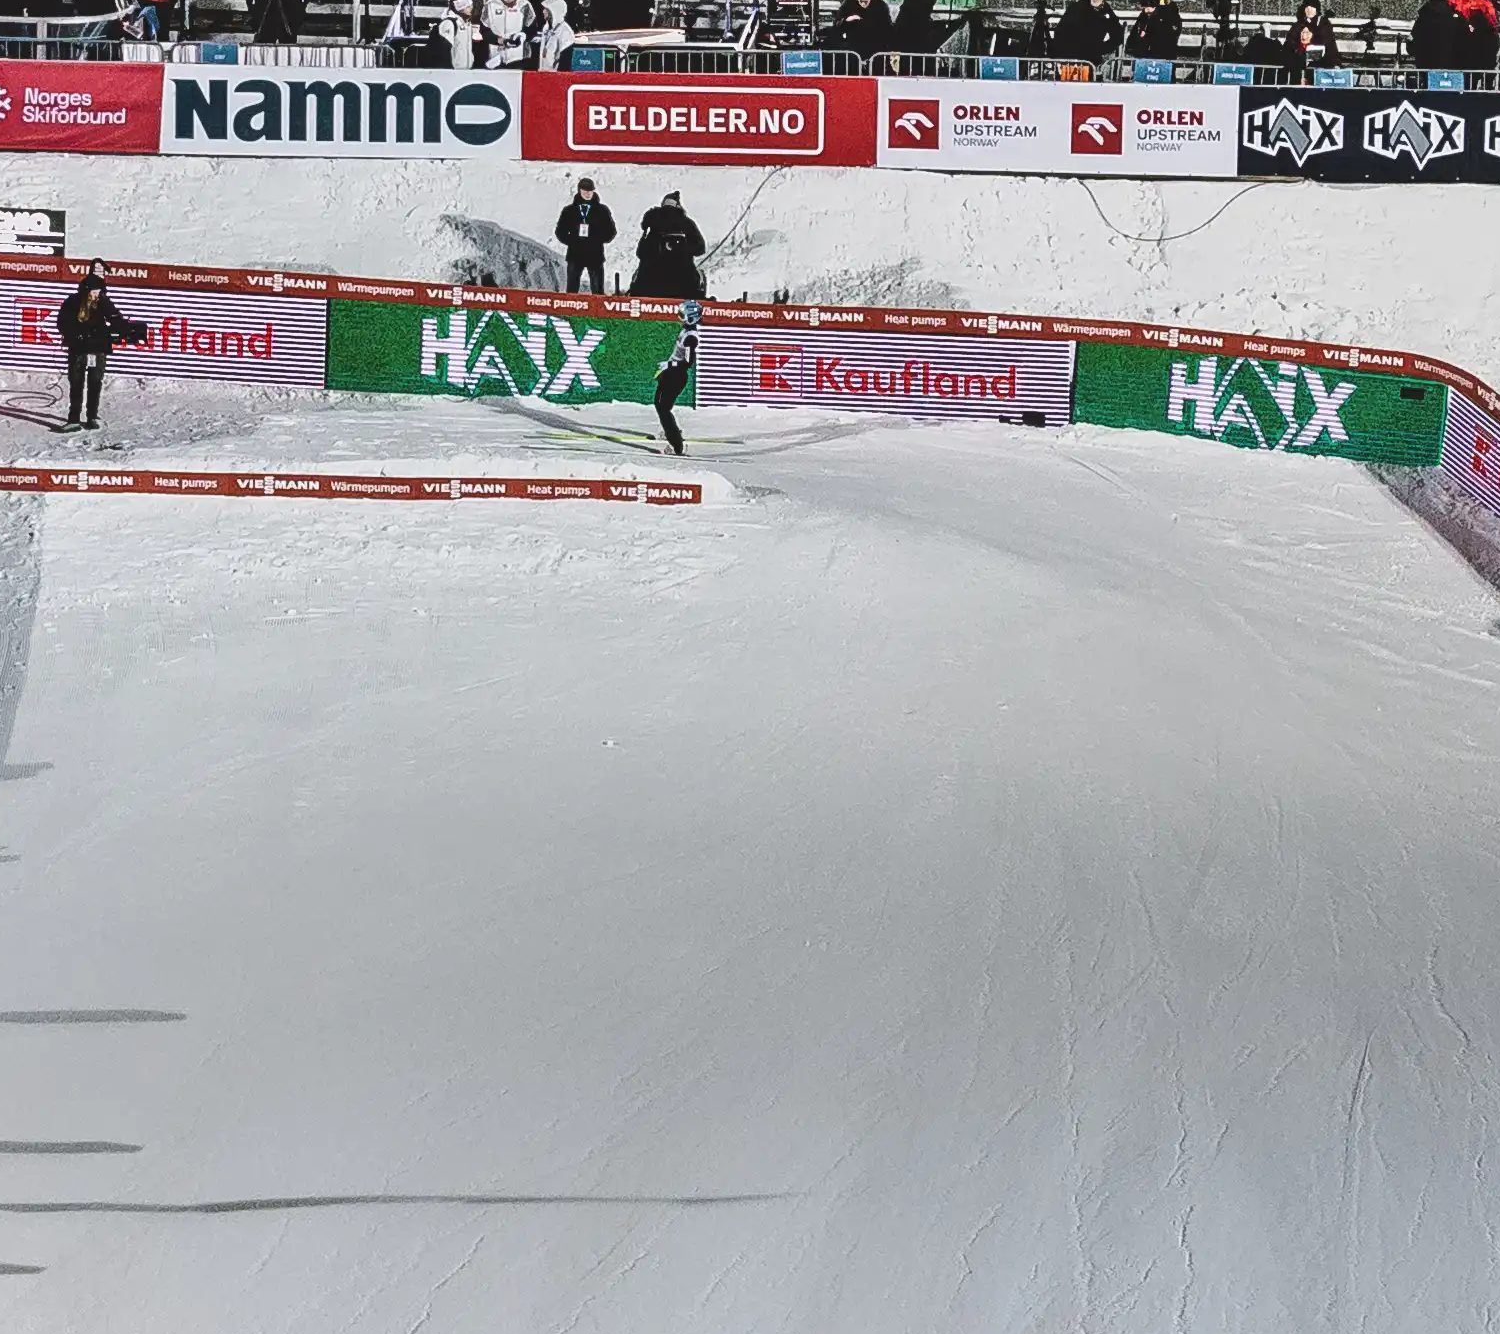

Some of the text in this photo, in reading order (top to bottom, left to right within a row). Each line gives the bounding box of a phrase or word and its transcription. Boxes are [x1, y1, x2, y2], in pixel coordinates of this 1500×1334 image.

[25, 87, 91, 107] Norges
[22, 107, 126, 125] Skiforbund
[169, 79, 511, 146] Nammo
[587, 106, 804, 135] BILDELER.NO
[953, 106, 1020, 121] ORLEN
[1136, 110, 1204, 126] ORLEN
[953, 124, 1037, 139] UPSTREAM
[1136, 128, 1221, 142] UPSTREAM
[953, 139, 999, 148] NORWAY
[1136, 142, 1183, 152] NORWAY
[168, 270, 191, 282] Heat
[195, 273, 229, 286] pumps
[247, 274, 327, 292] VIESSMANN
[338, 282, 414, 298] Wärmepumpen
[427, 286, 507, 305] VIESSMANN
[527, 296, 551, 308] Heat
[554, 299, 589, 313] pumps
[783, 308, 864, 326] VIESSMANN
[885, 314, 908, 326] Heat
[911, 317, 946, 330] pumps
[960, 316, 1042, 334] VIESSMANN
[1053, 323, 1131, 339] Wärmepumpen
[1142, 329, 1223, 347] VIESSMANN
[1244, 341, 1267, 354] Heat
[1270, 343, 1306, 358] pumps
[1323, 349, 1404, 367] VIESSMANN
[816, 356, 1017, 399] Kaufland
[51, 472, 134, 490] VIESSMANN
[154, 477, 179, 488] Heat
[182, 479, 217, 491] pumps
[237, 476, 320, 494] VIESSMANN
[331, 481, 411, 494] Wärmepumpen
[423, 480, 505, 498] VIESSMANN
[527, 485, 551, 496] Heat
[554, 487, 590, 500] pumps
[610, 485, 692, 503] VIESSMANN
